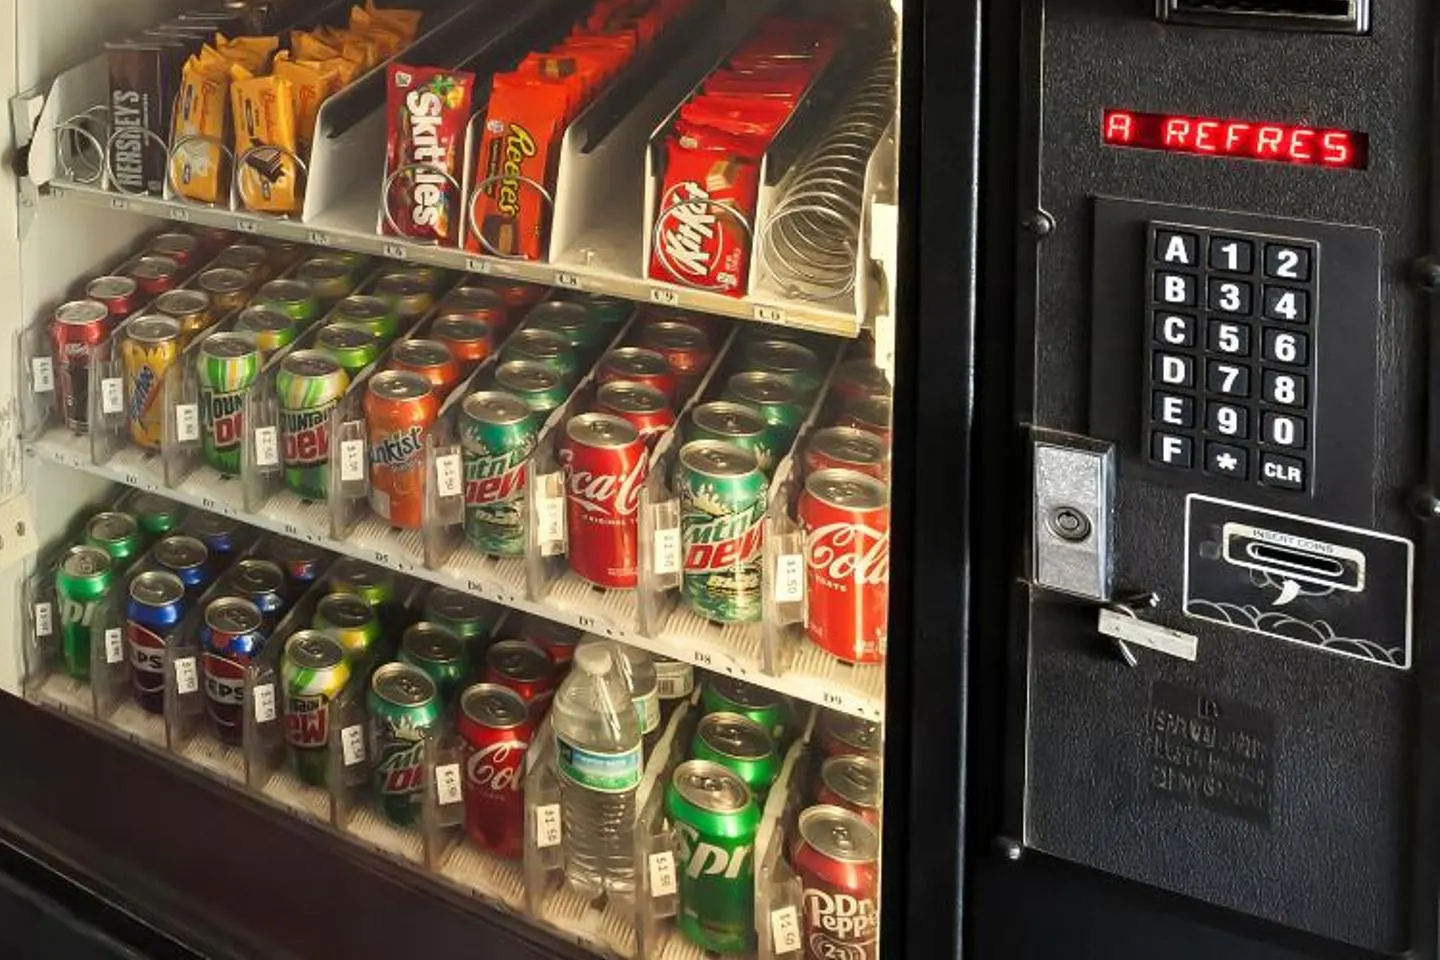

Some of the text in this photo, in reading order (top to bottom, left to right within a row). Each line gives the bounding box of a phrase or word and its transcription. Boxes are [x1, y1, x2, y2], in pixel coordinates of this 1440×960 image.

[113, 89, 144, 188] HERSHEY'S
[1107, 113, 1349, 163] A REFRES
[406, 90, 447, 226] Skittles
[497, 122, 536, 217] Reese's
[1165, 236, 1188, 264] A
[1221, 243, 1238, 270] 1
[1276, 251, 1298, 278] 2
[1165, 277, 1186, 303] B
[1219, 284, 1240, 311] 3
[1274, 293, 1297, 319] 4
[1164, 317, 1185, 343] C
[1219, 325, 1239, 353] 5
[1274, 334, 1295, 362] 6
[1162, 358, 1185, 383] D
[1218, 367, 1239, 393] 7
[1274, 376, 1295, 403] 8
[1163, 399, 1183, 425] E
[1217, 408, 1238, 434] 9
[1273, 418, 1294, 445] 0
[1162, 438, 1182, 463] F
[1263, 461, 1302, 483] CLR
